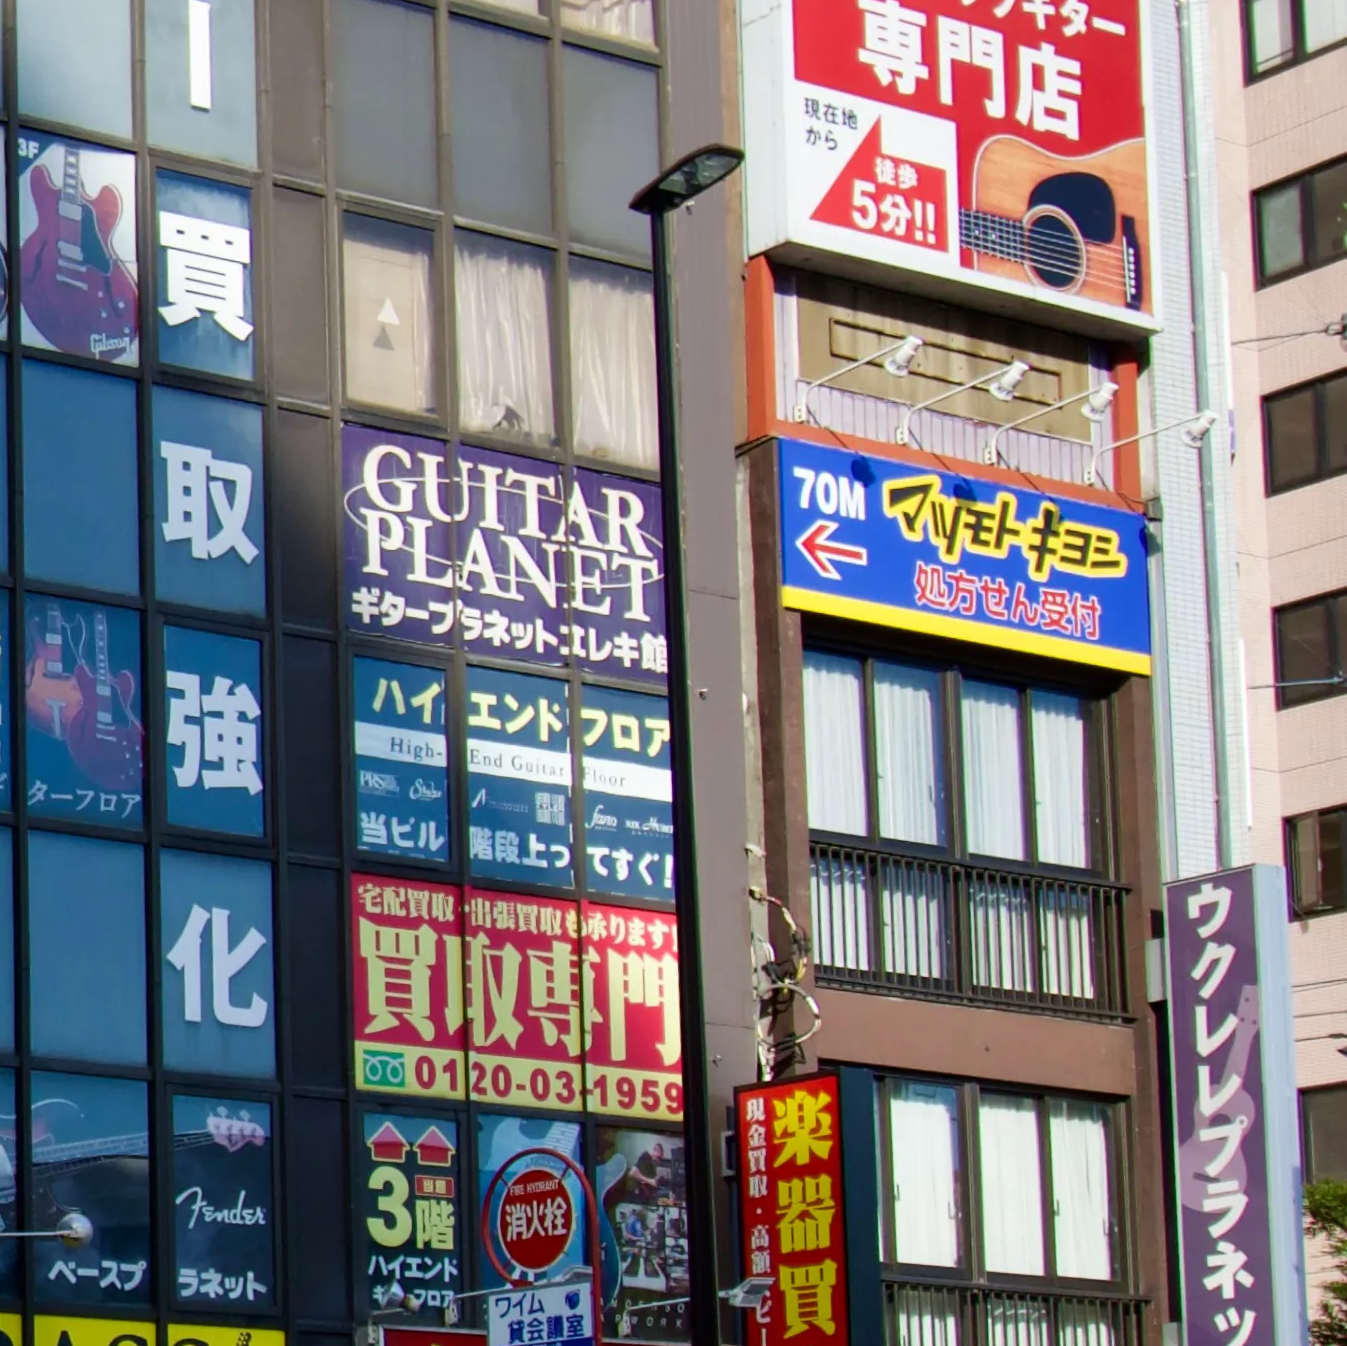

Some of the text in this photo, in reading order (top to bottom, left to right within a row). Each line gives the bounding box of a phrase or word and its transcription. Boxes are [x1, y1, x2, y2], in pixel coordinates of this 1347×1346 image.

[804, 97, 859, 131] 現在地
[18, 138, 40, 159] 3F
[805, 127, 838, 151] から
[874, 155, 918, 189] 徒歩
[90, 333, 131, 354] Gibson
[364, 445, 654, 558] GUITAR
[794, 467, 866, 519] 70M
[885, 476, 1125, 579] マツモトキヨシ
[360, 506, 659, 623] PLANET
[915, 562, 1102, 640] 処方せん受付
[372, 678, 671, 758] ハイエンドフロア
[511, 754, 565, 778] Guitar
[359, 917, 681, 1067] 買取専門
[414, 1055, 684, 1115] 0120-03-1959
[175, 1186, 266, 1229] Fender
[505, 1195, 567, 1242] 消火栓
[368, 1255, 458, 1283] ハイエンド
[495, 1293, 545, 1319] ワイム
